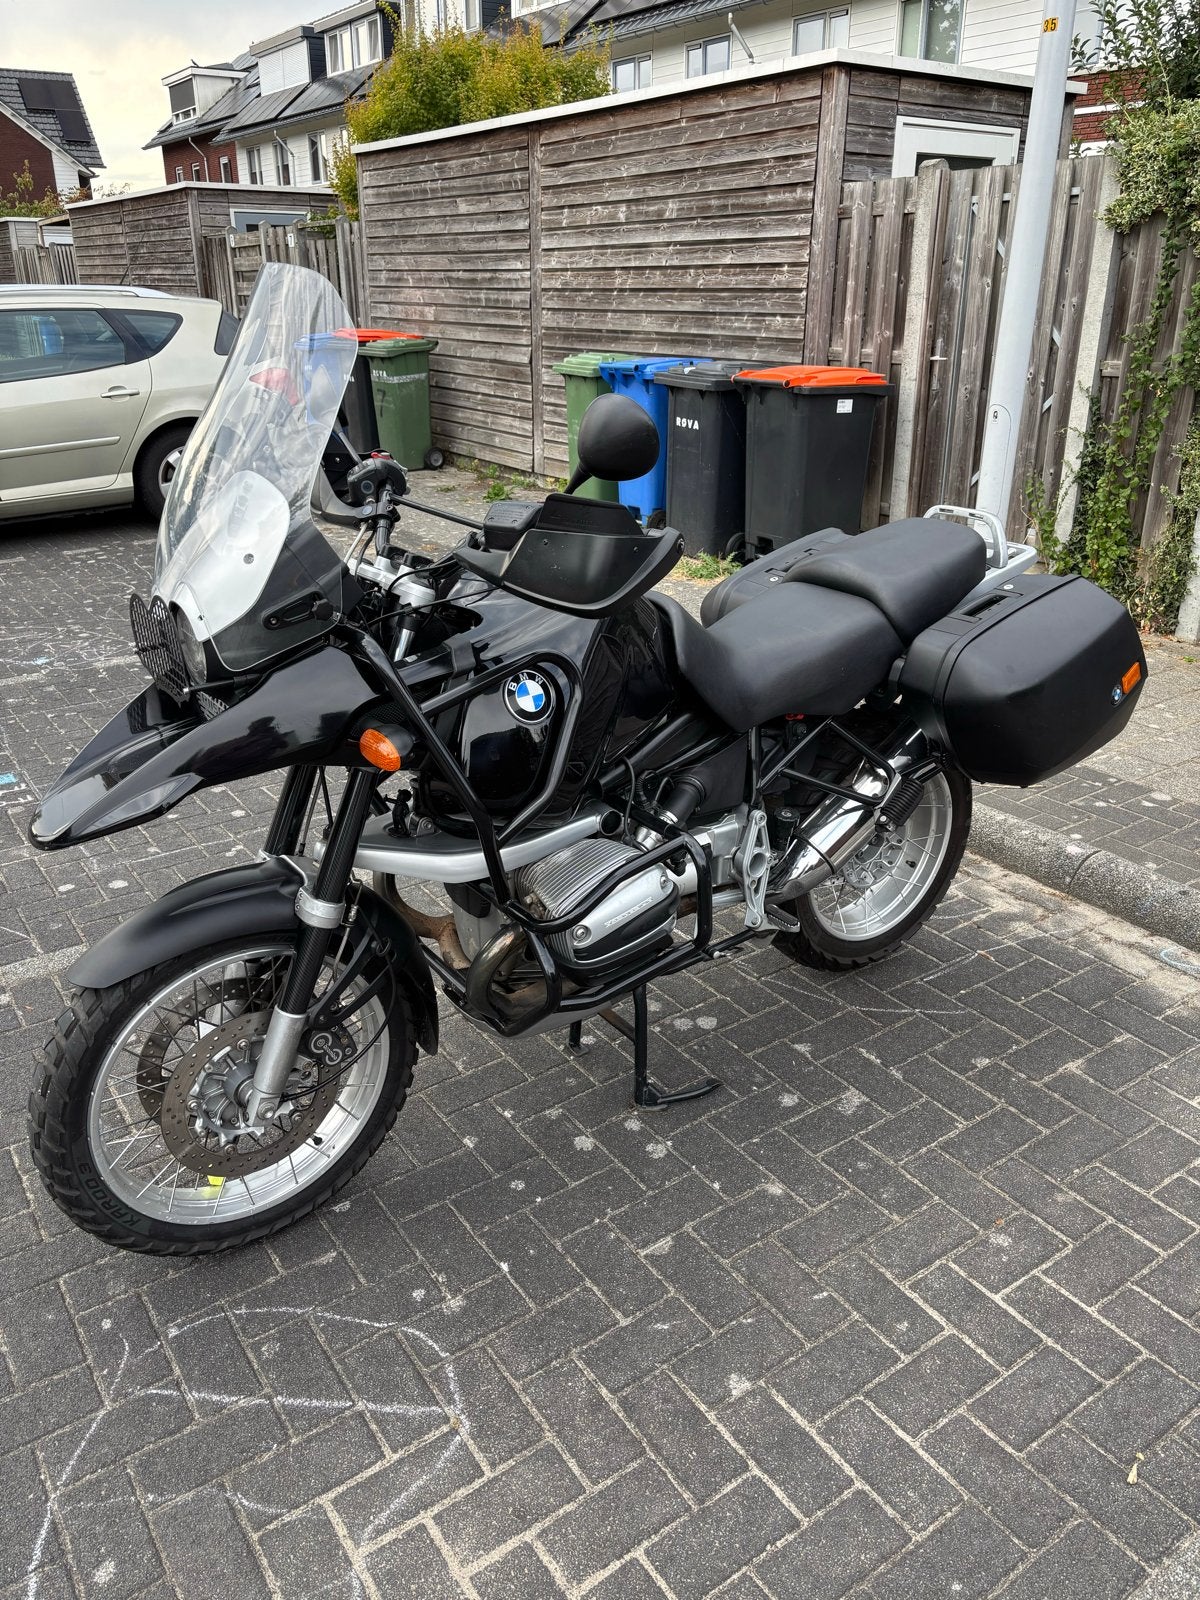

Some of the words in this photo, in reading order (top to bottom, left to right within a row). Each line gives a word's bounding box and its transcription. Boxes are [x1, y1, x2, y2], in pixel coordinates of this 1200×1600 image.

[1043, 18, 1057, 32] 35
[377, 388, 386, 418] 7
[675, 416, 699, 430] ROVA
[508, 672, 544, 692] BMW
[84, 1177, 142, 1227] KAROO
